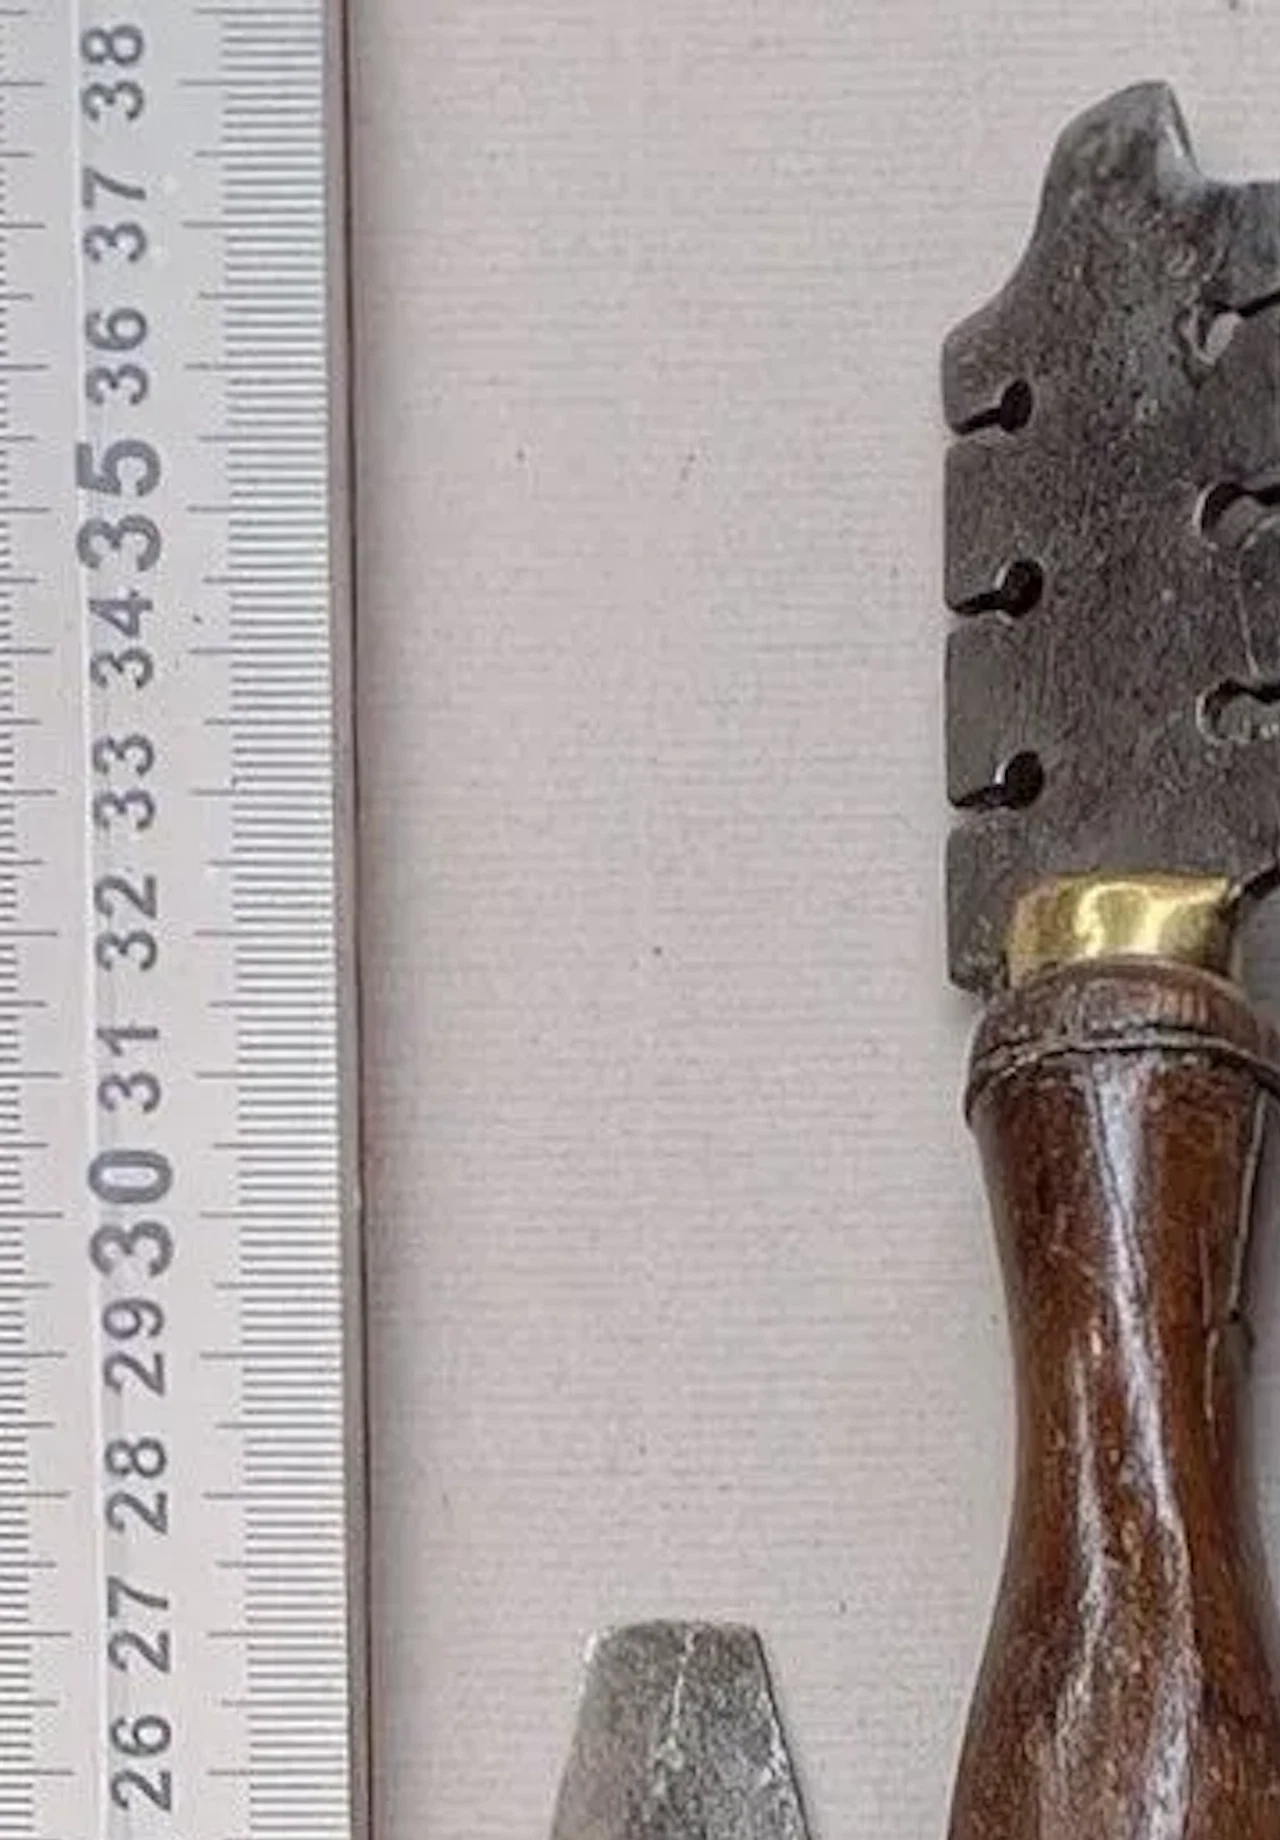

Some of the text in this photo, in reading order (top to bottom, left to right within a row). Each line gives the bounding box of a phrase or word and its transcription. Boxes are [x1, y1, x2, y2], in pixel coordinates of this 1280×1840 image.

[79, 25, 144, 122] 38
[82, 166, 148, 263] 37
[84, 308, 148, 406] 36
[75, 440, 162, 572] 35
[88, 588, 154, 690] 34
[91, 733, 156, 833] 33
[93, 874, 158, 972] 32
[95, 1025, 161, 1114] 31
[87, 1150, 174, 1278] 30
[101, 1297, 165, 1397] 29
[103, 1437, 168, 1535] 28
[106, 1576, 170, 1674] 27
[108, 1715, 172, 1813] 26
